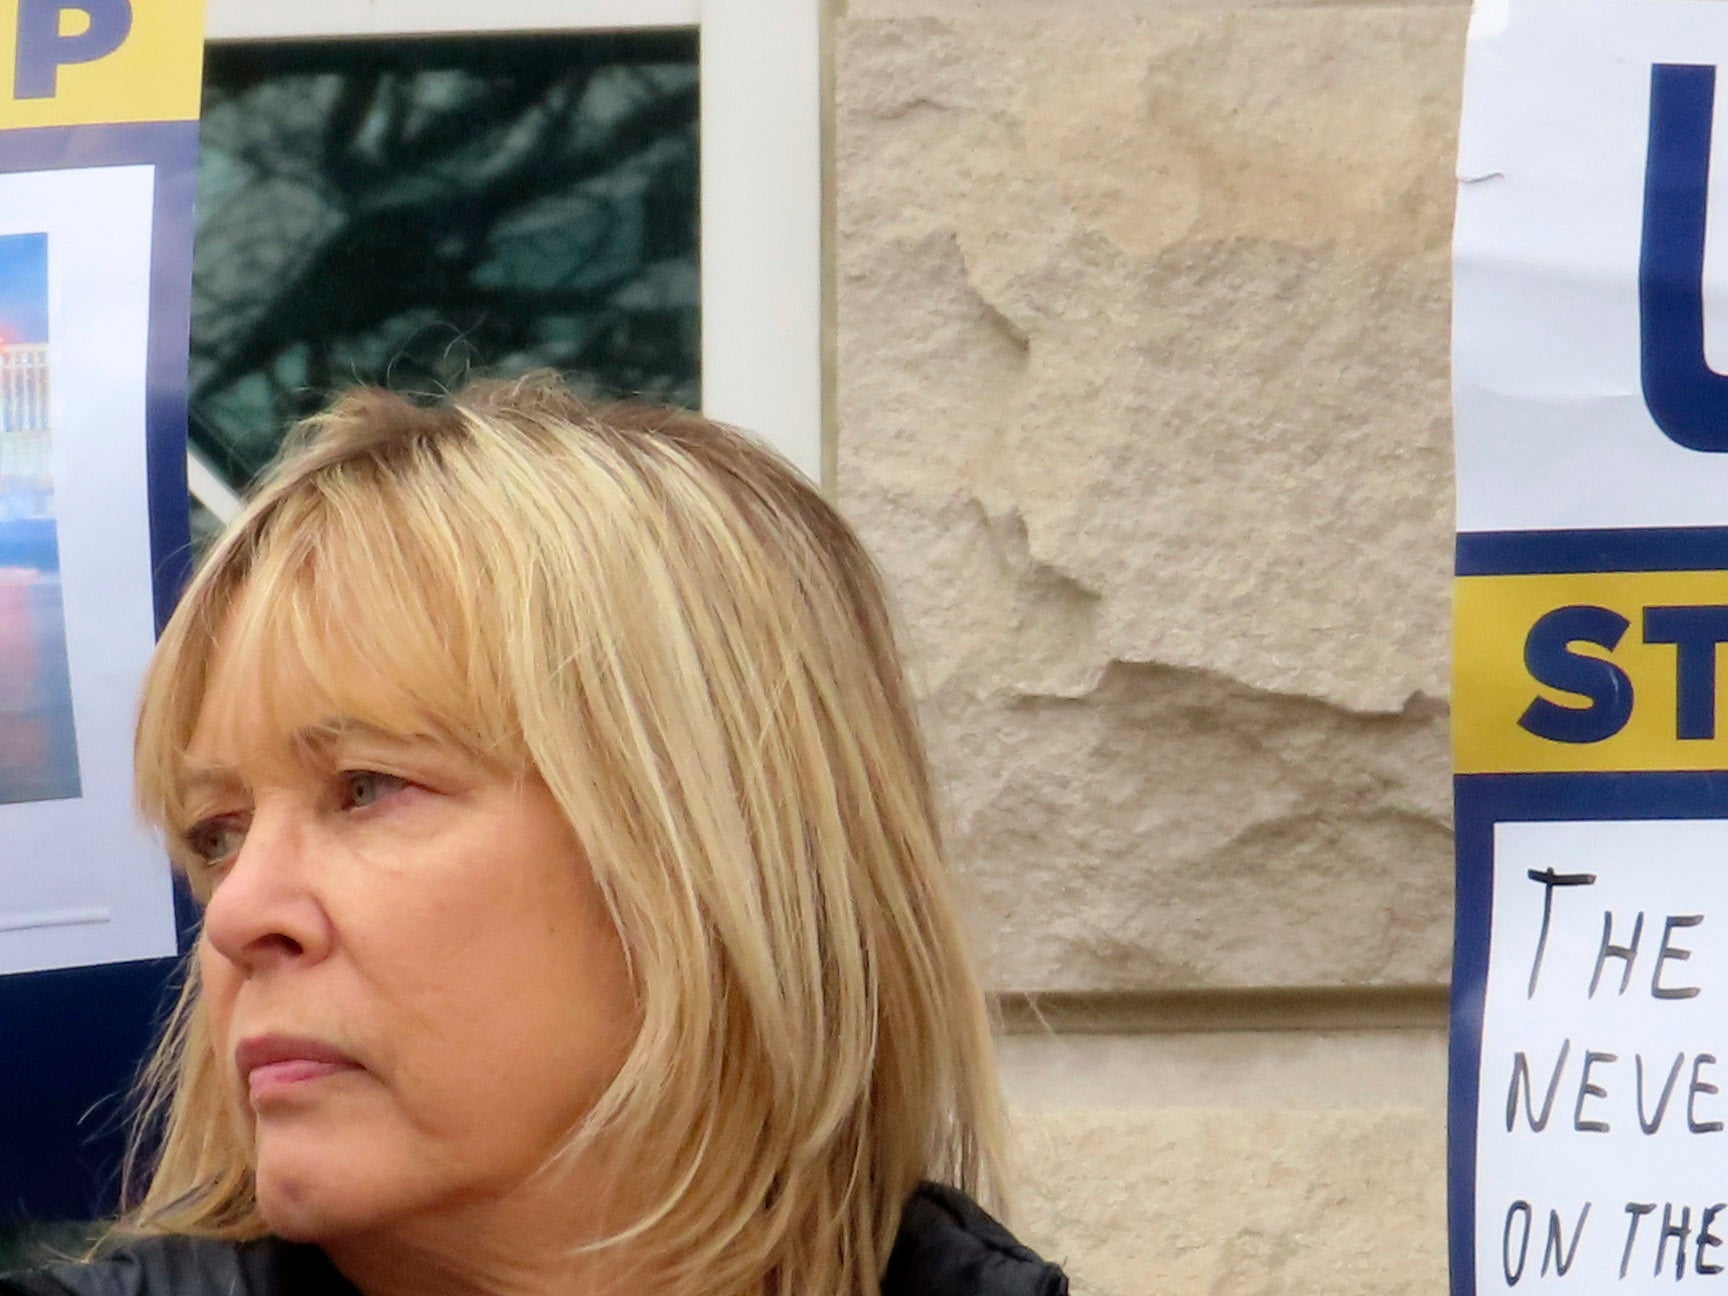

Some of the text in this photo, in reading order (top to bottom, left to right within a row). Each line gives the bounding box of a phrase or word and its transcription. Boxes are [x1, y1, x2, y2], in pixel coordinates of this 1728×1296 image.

[1527, 867, 1705, 1001] THE
[1502, 1199, 1592, 1288] ON
[1618, 1201, 1728, 1282] THE
